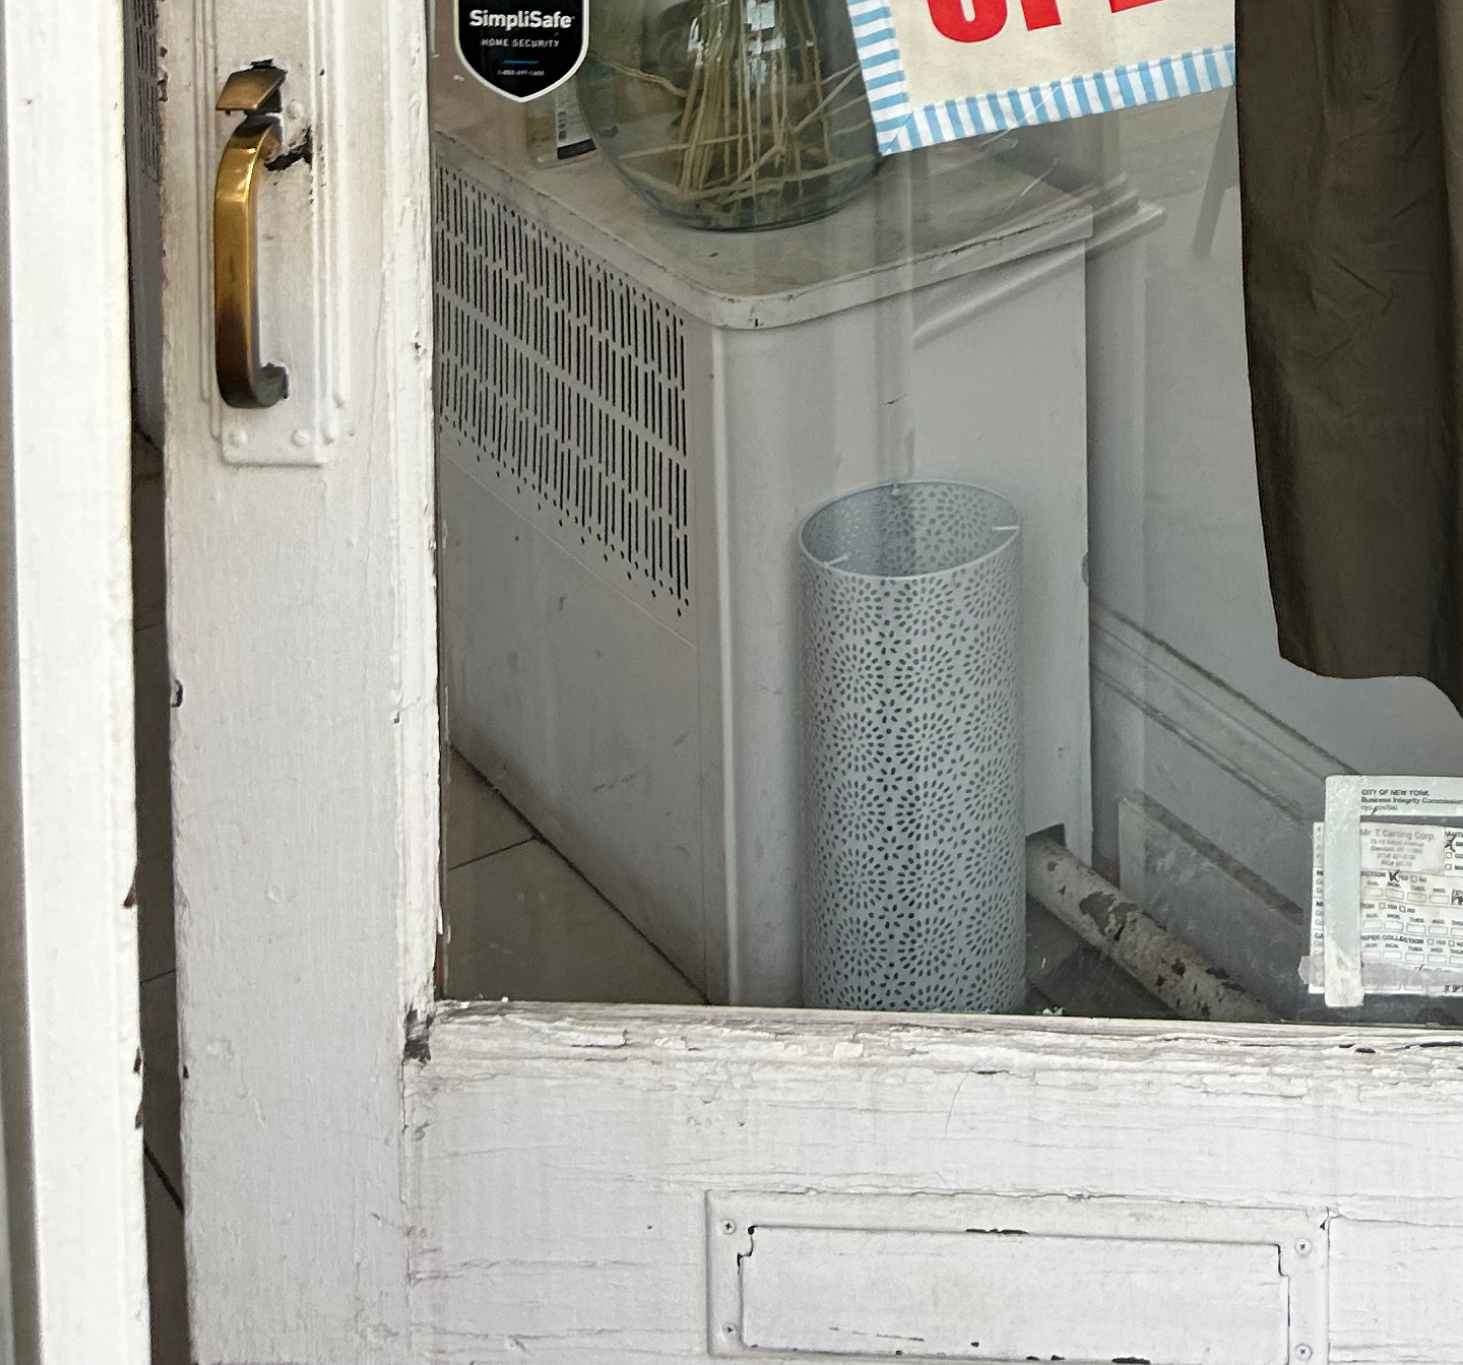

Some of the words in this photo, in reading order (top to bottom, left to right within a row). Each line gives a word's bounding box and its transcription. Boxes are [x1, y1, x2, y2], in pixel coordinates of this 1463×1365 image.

[469, 9, 572, 31] SimpliSafe
[480, 38, 509, 47] HOME
[511, 38, 560, 48] SECURITY
